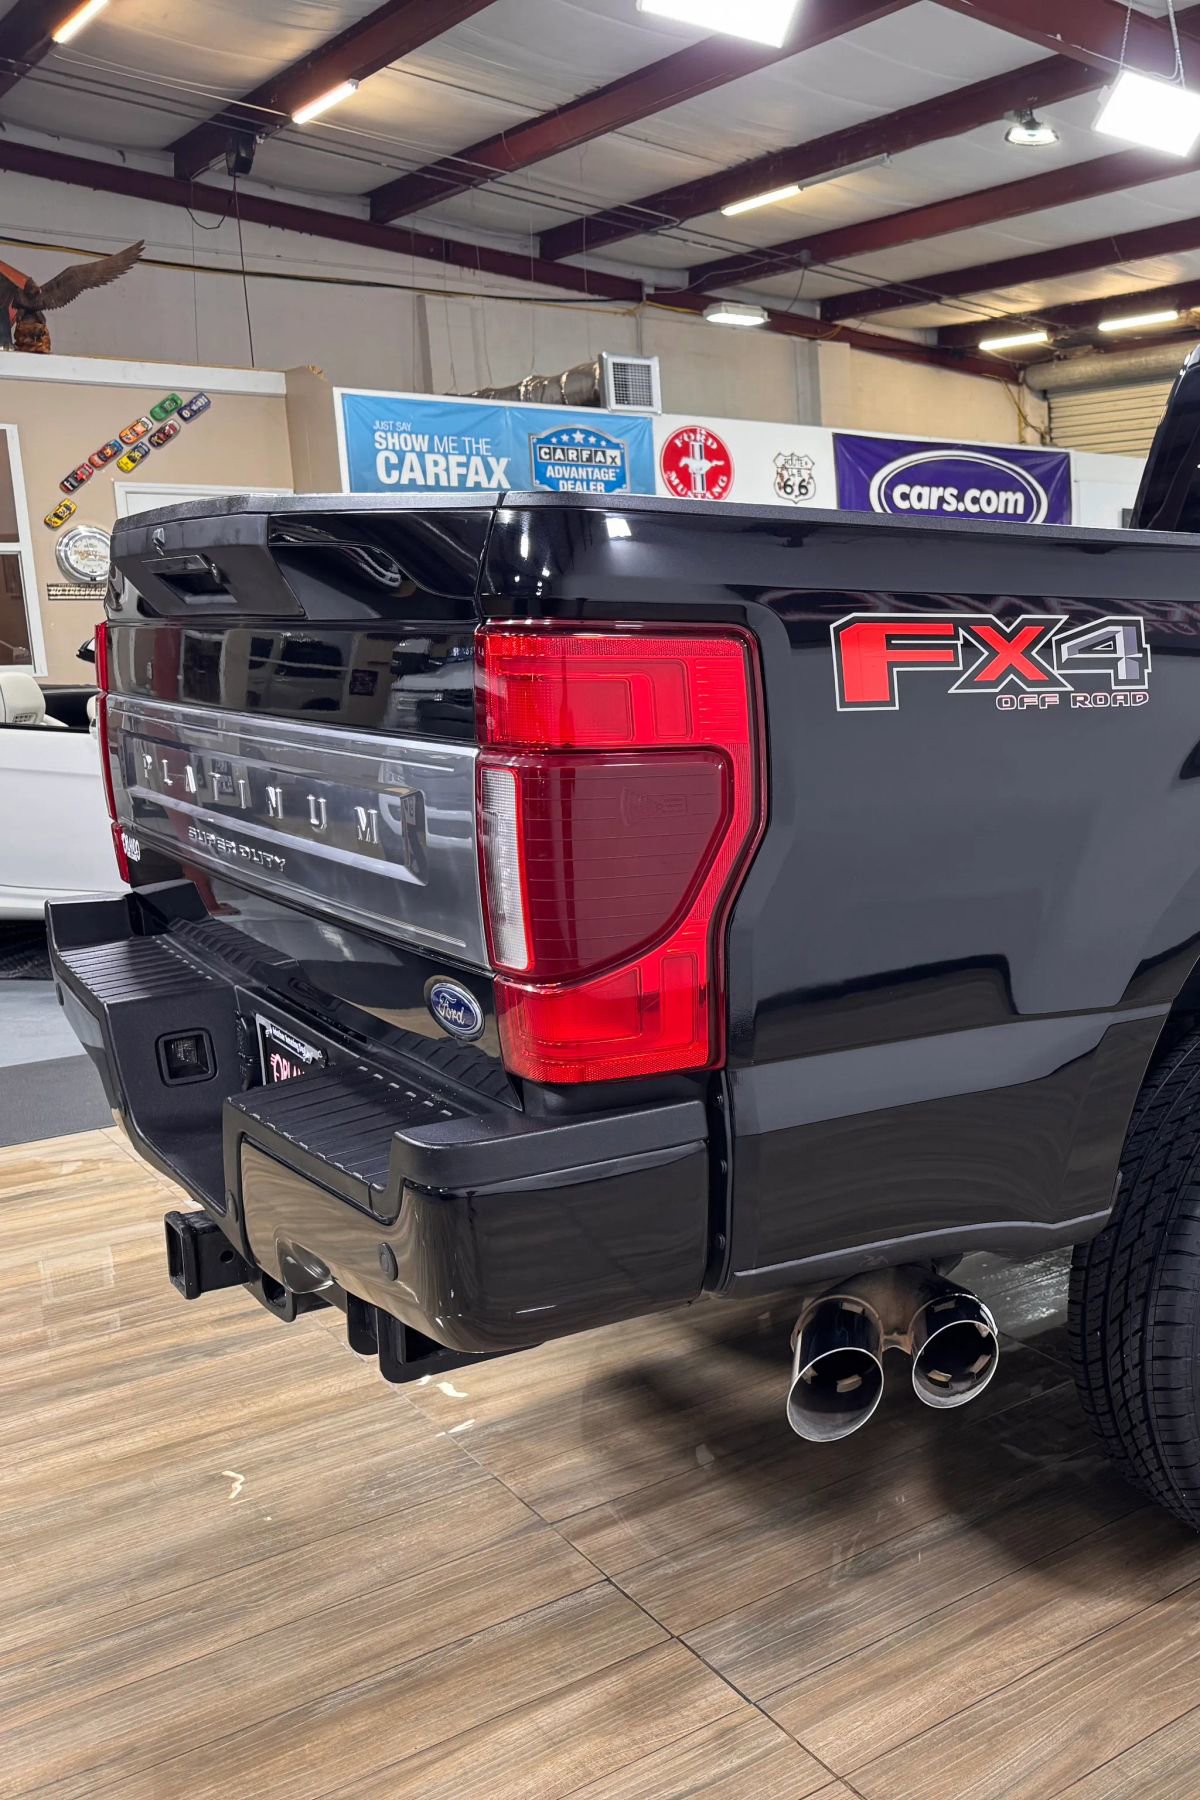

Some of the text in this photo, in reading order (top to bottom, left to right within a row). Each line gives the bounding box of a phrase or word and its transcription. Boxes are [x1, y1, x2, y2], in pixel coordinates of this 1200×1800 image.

[373, 420, 412, 432] JUST SAY
[374, 432, 491, 455] SHOW ME THE
[674, 430, 718, 450] FORD
[540, 446, 619, 466] CARFAX
[376, 451, 509, 489] CARFAX
[546, 465, 617, 481] ADVANTAGE
[559, 479, 604, 493] DEALER
[784, 478, 808, 496] 66
[892, 484, 1024, 515] cars.com
[830, 612, 1152, 711] FX4
[996, 692, 1149, 710] OFF ROAD
[142, 754, 379, 844] PLATINUM
[188, 825, 286, 872] SUPER DUTY
[436, 992, 465, 1025] Ford
